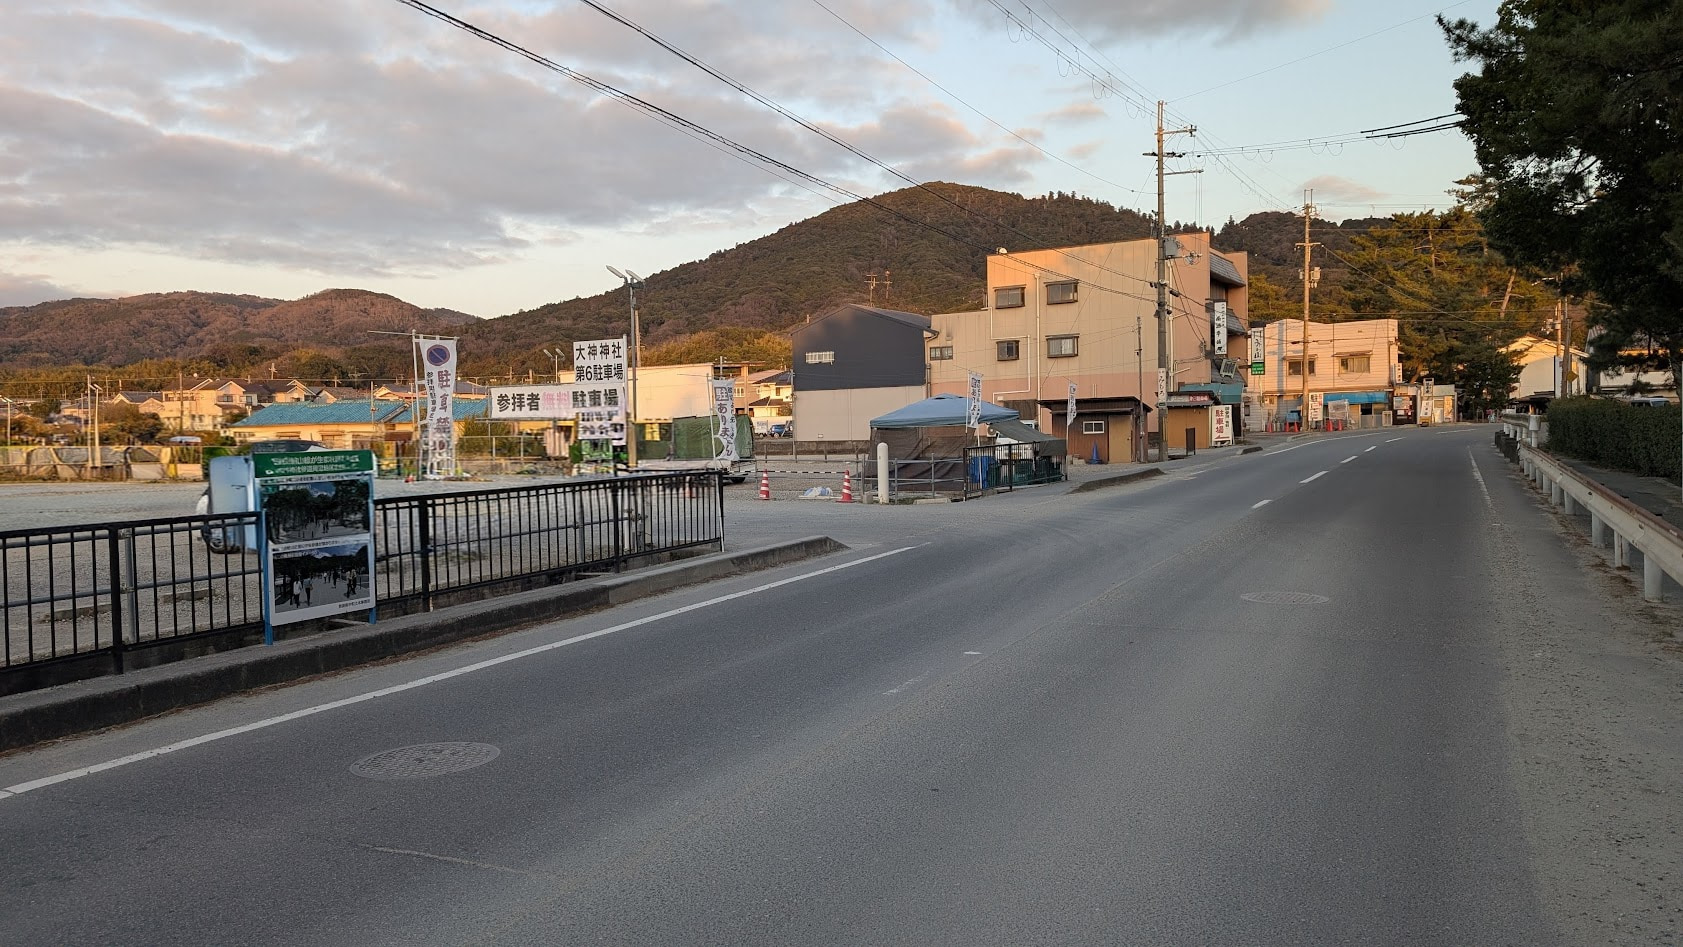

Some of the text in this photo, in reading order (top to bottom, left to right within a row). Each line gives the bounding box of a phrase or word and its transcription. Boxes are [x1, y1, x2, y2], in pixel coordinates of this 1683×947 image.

[575, 341, 622, 361] 大神神社
[575, 363, 623, 382] 第6駐車場
[1215, 409, 1225, 434] 駐車場
